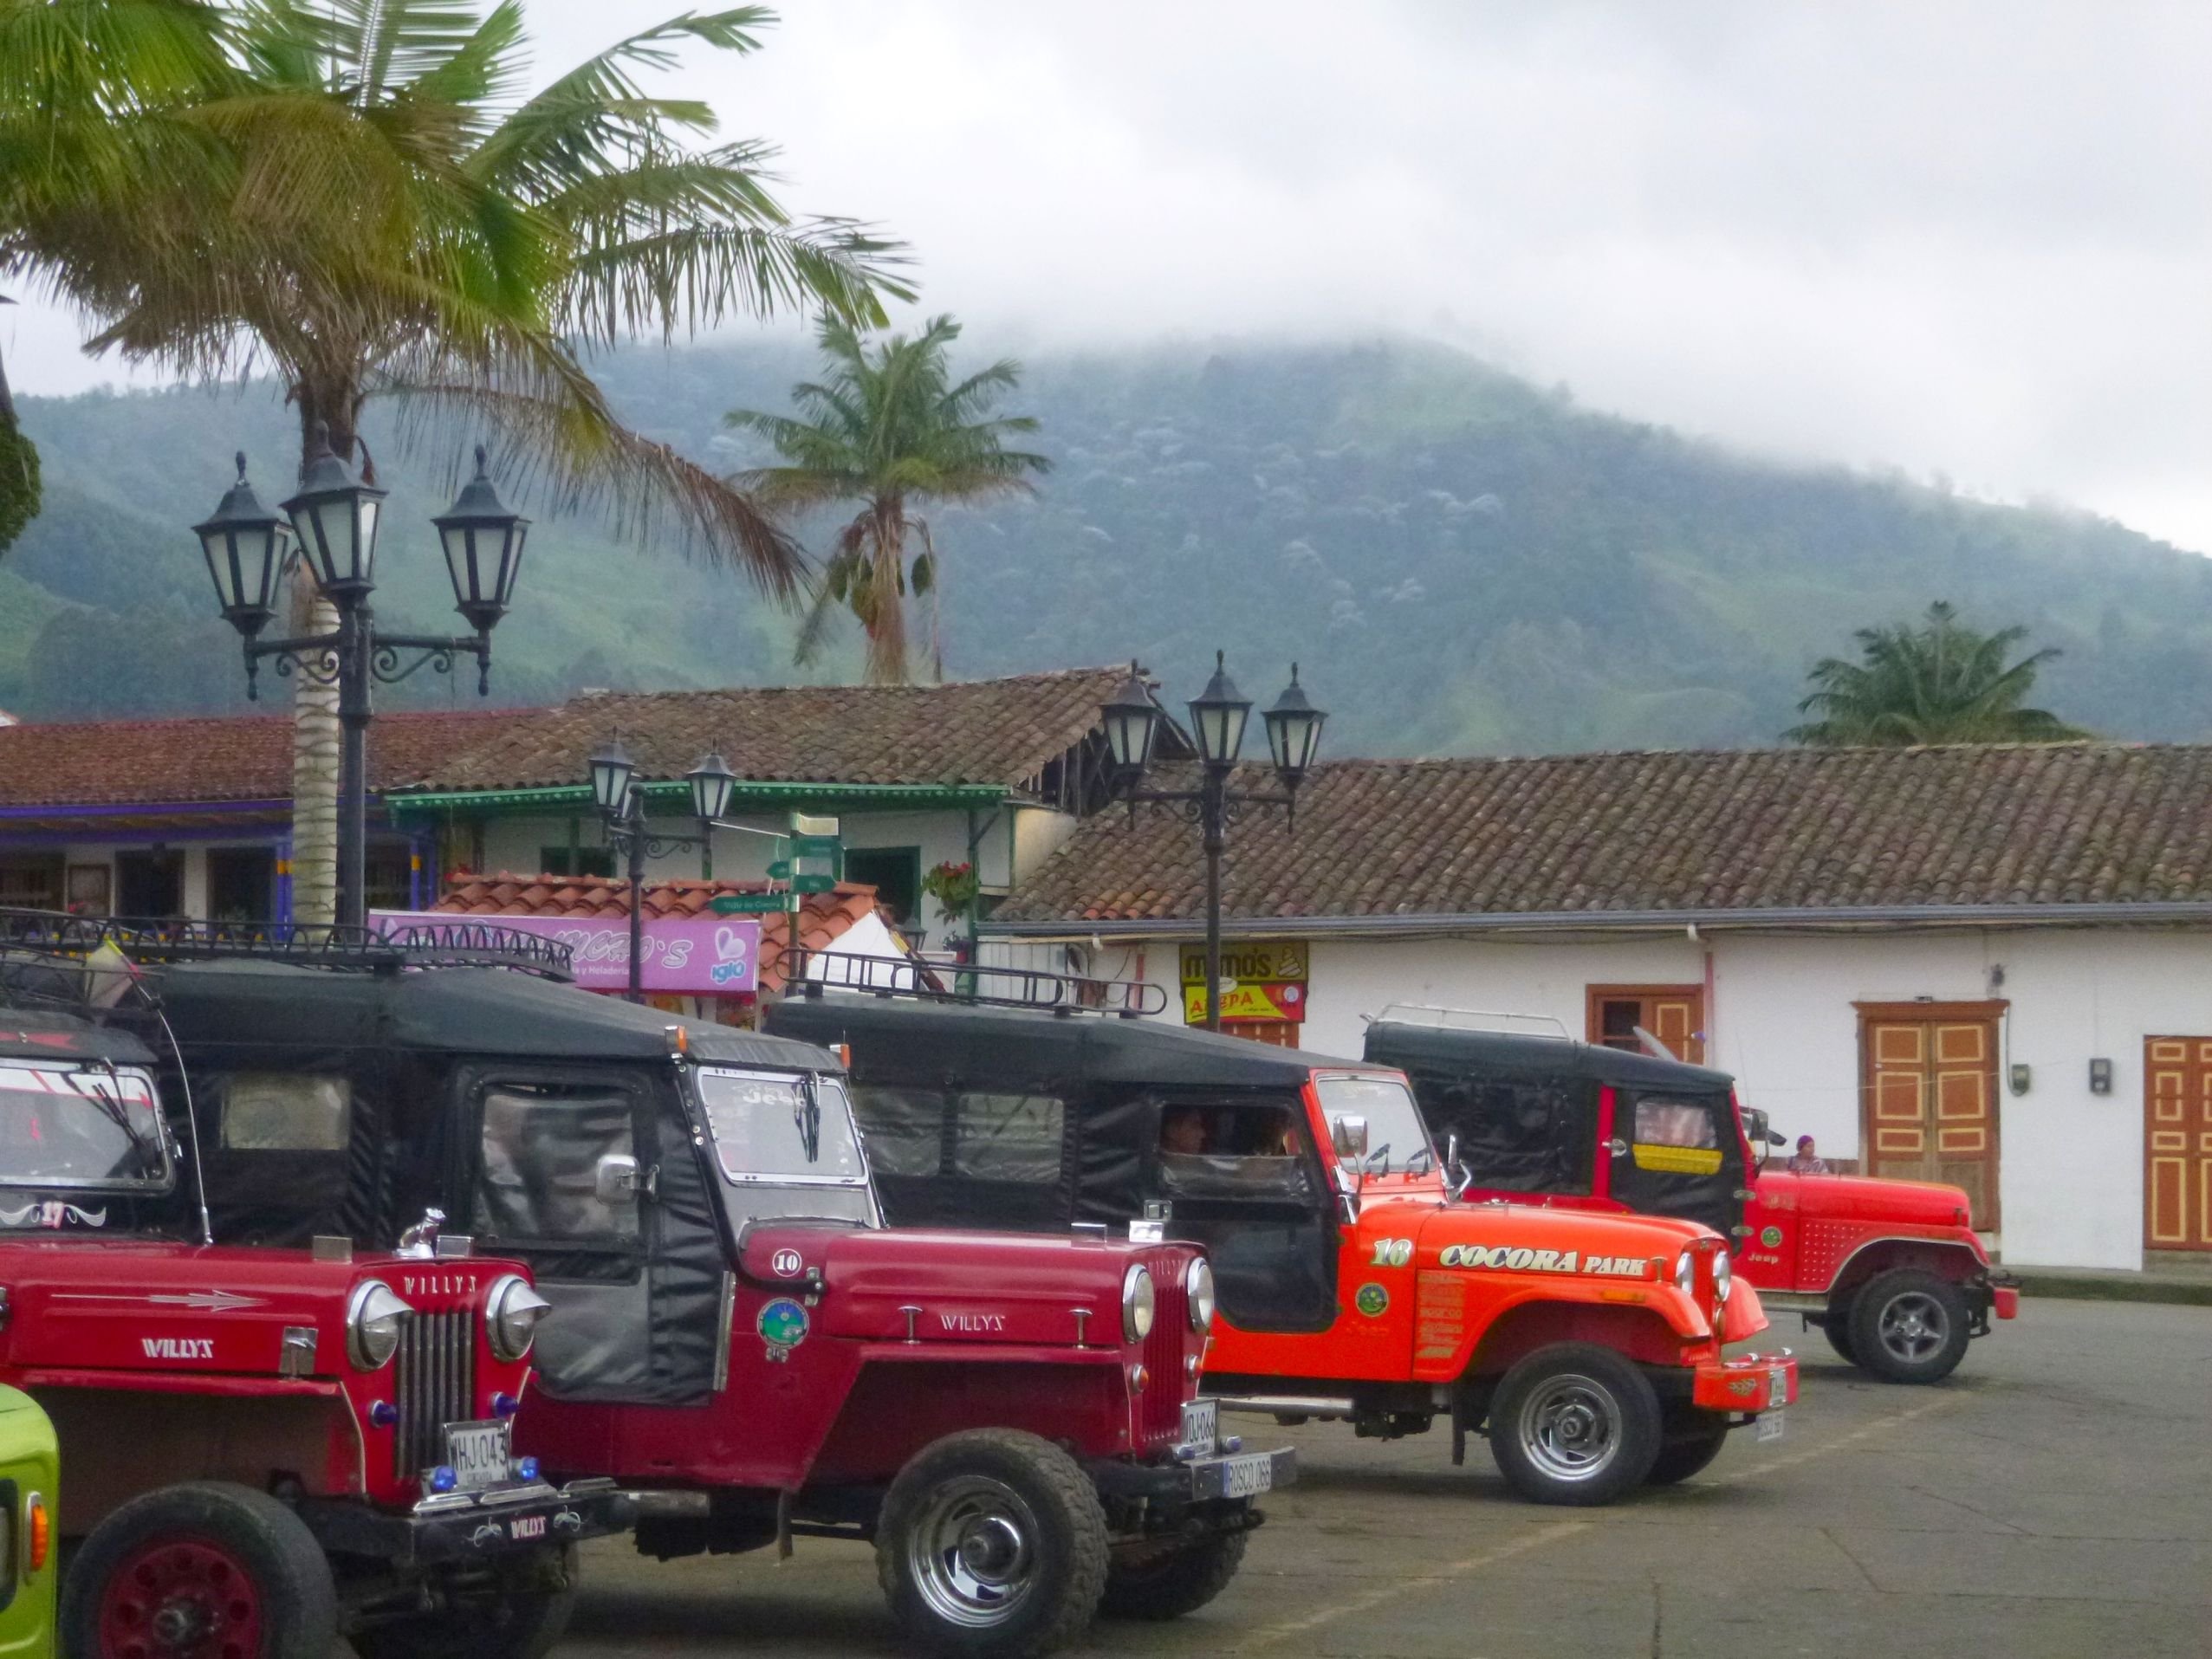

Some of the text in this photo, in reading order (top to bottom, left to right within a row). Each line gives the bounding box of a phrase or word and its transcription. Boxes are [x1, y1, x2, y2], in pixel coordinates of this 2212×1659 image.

[776, 1254, 798, 1271] 10
[1439, 1243, 1646, 1276] COCORA PARK
[1748, 1254, 1779, 1265] Jeep
[404, 1274, 476, 1295] WILLYS
[940, 1315, 1005, 1331] WILLYS
[141, 1338, 214, 1358] WILLYS
[510, 1517, 547, 1539] WILLYS
